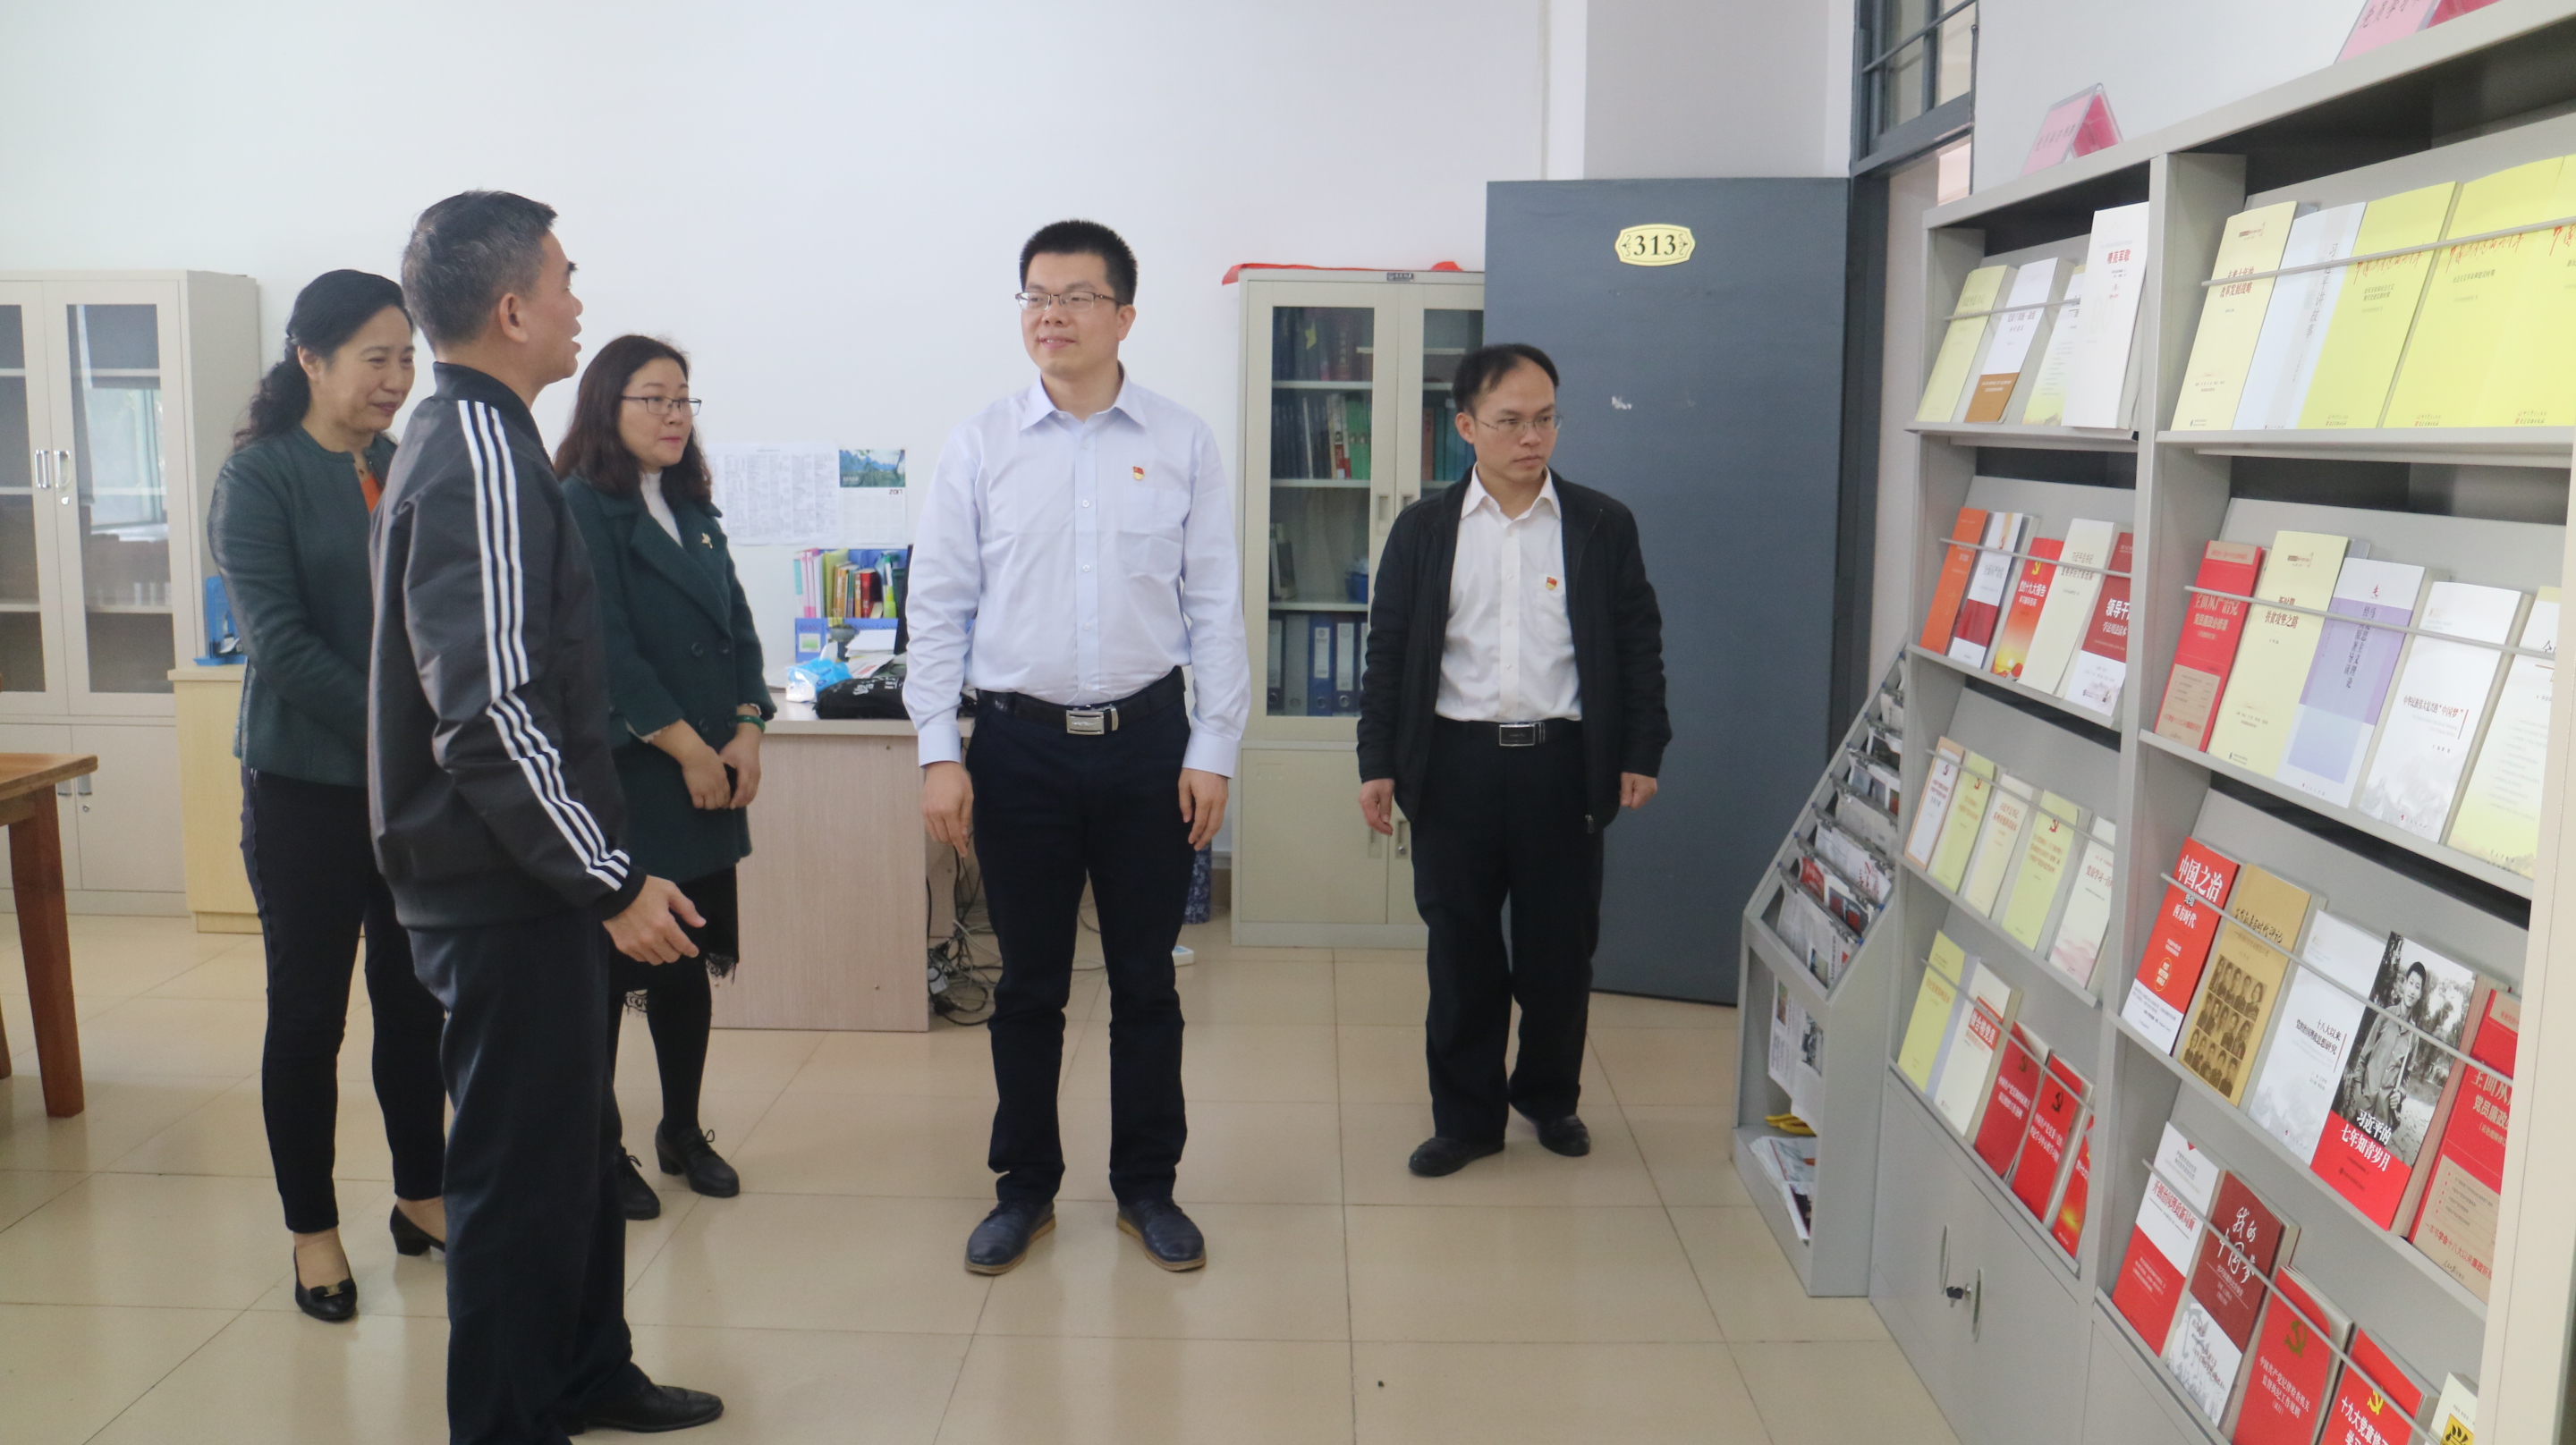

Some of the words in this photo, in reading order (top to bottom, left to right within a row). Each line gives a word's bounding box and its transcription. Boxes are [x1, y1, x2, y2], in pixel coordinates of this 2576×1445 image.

[1634, 234, 1676, 256] 313
[2219, 281, 2253, 298] 改革发展战略
[2306, 243, 2338, 339] 习平讲故事
[2018, 579, 2046, 597] 党的十九大报告
[2106, 597, 2131, 621] 领导干
[2264, 611, 2299, 630] 扶贫攻坚之路
[2178, 854, 2224, 903] 中国之治
[2172, 903, 2198, 929] 西方时代
[2317, 1018, 2342, 1042] 十八大以来
[2471, 1061, 2512, 1106] 全面从
[2357, 1108, 2392, 1145] 习近平的
[2341, 1124, 2392, 1172] 七年知青岁月
[2233, 1205, 2257, 1243] 我的
[2217, 1228, 2256, 1284] 中国梦
[2259, 1356, 2310, 1412] 中国共产党纪律检查机关
